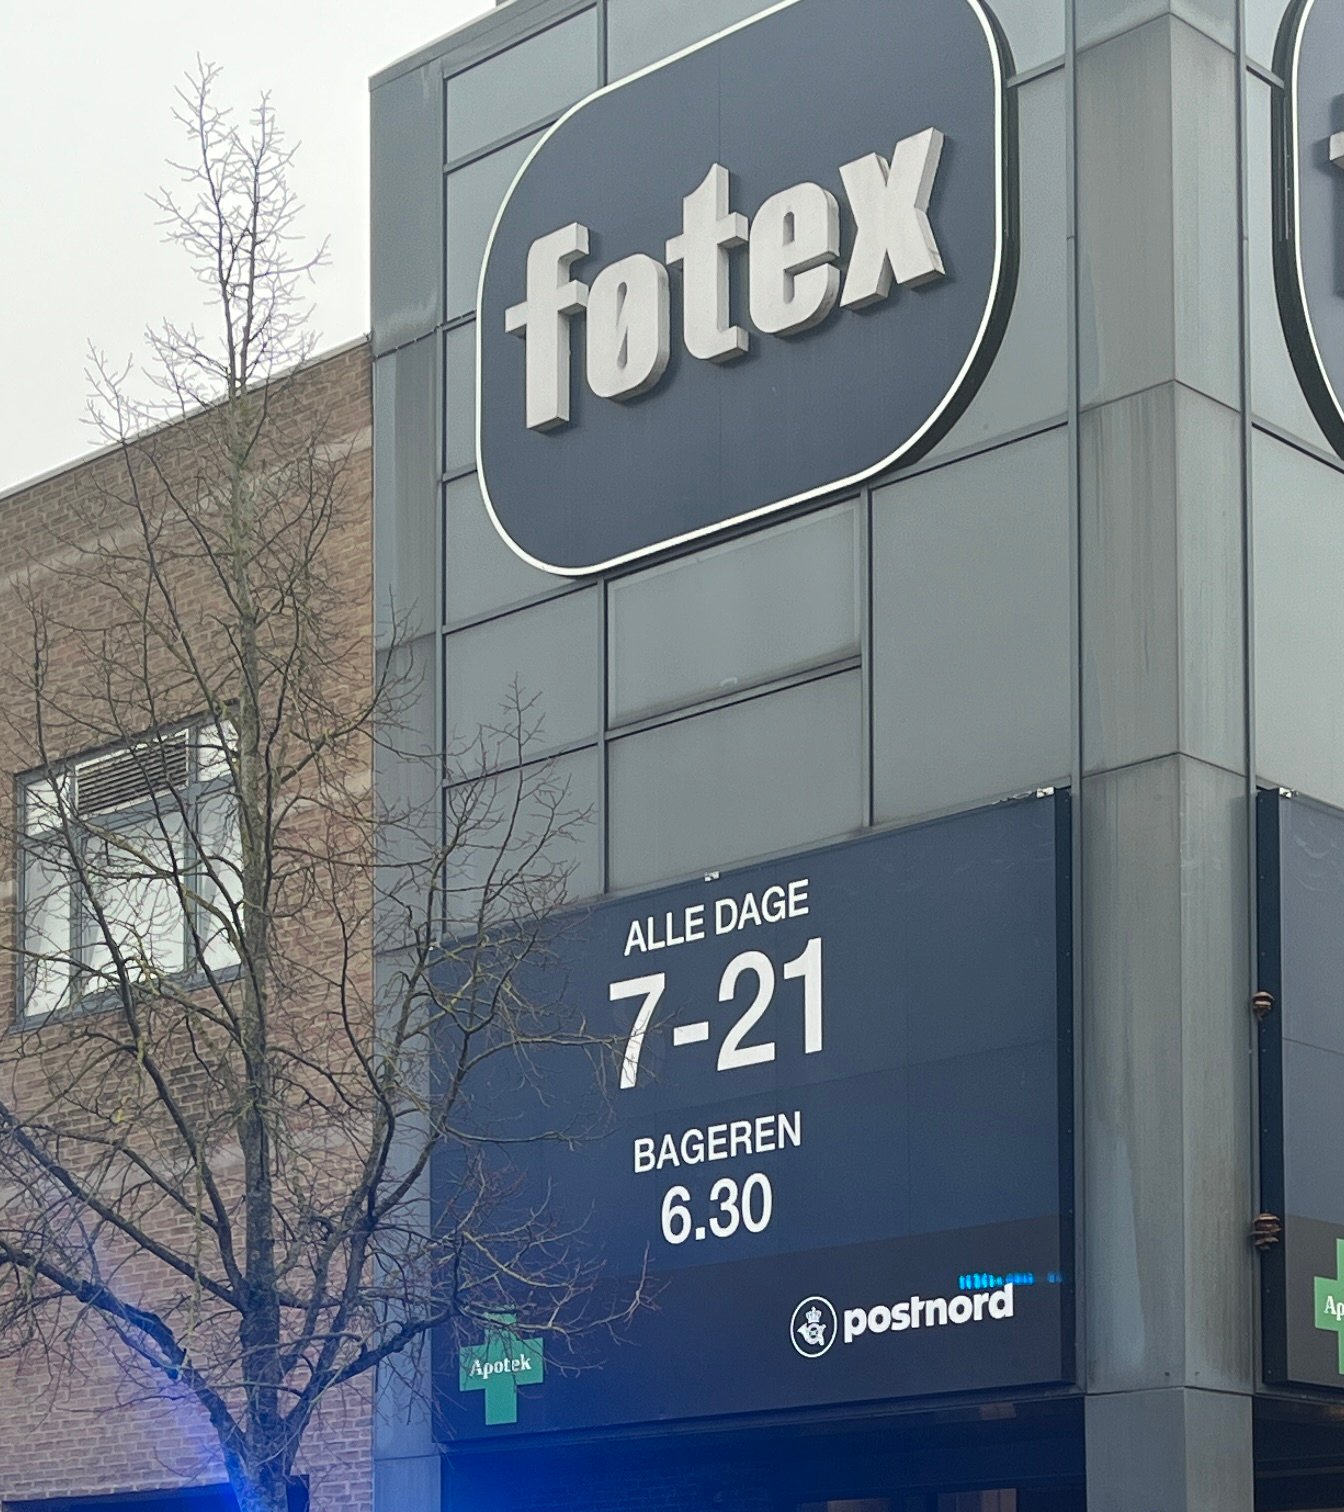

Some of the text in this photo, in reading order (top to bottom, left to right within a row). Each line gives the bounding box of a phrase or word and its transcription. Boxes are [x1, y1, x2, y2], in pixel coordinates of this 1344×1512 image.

[504, 126, 946, 433] føtex
[623, 878, 809, 956] ALLE DAGE
[609, 936, 823, 1089] 7-21
[633, 1110, 802, 1174] BAGEREN
[661, 1172, 773, 1244] 6.30
[843, 1283, 1013, 1343] postnord
[468, 1353, 532, 1380] Apotek
